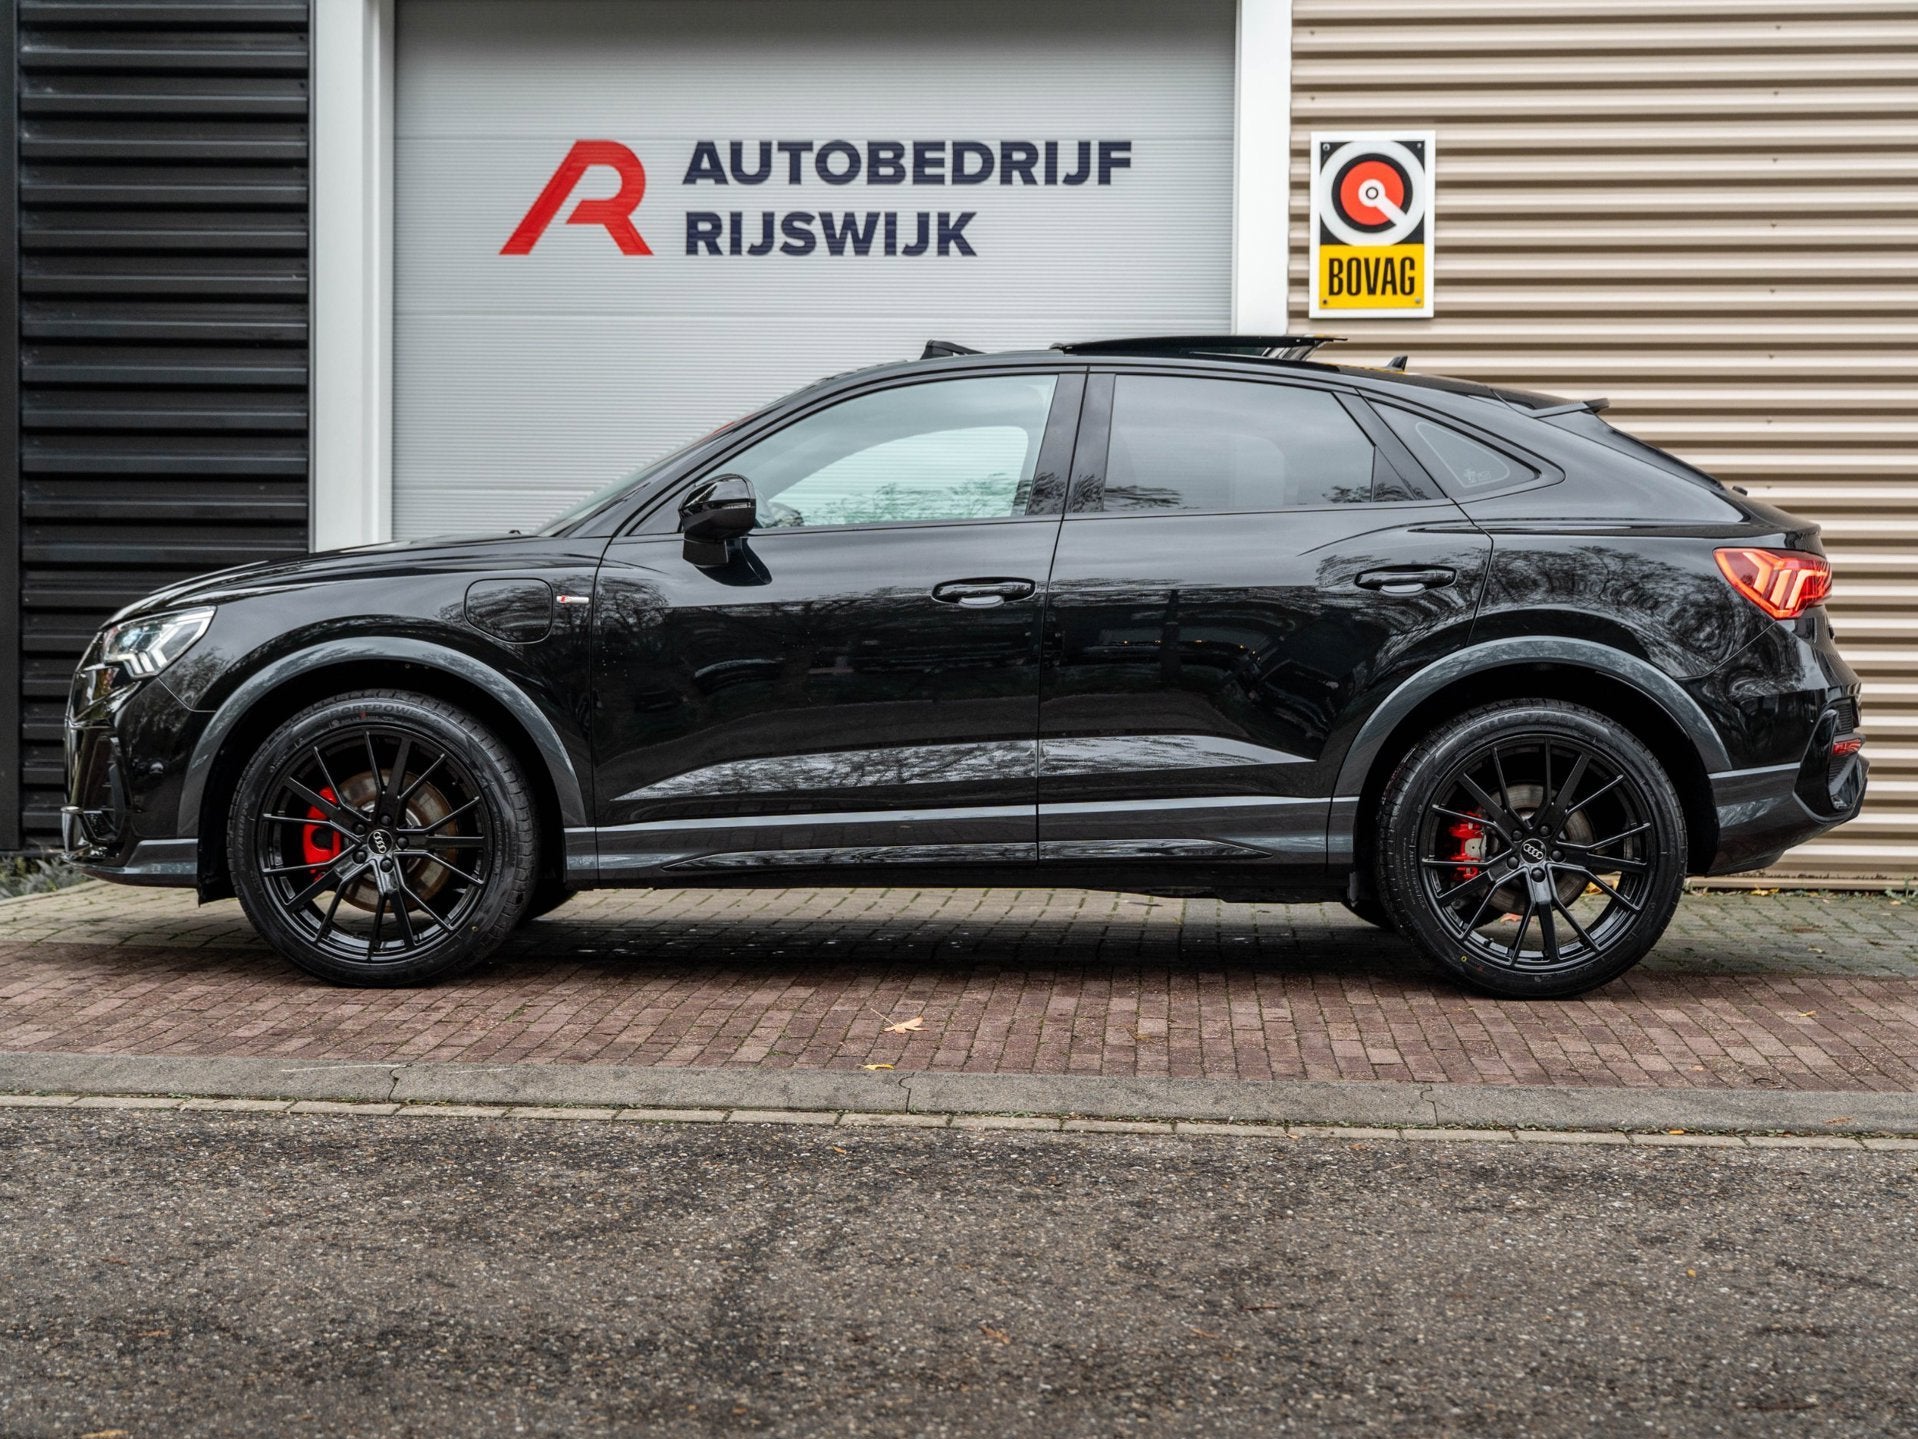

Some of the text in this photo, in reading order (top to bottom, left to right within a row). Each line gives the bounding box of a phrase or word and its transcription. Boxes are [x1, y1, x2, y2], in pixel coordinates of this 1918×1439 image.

[683, 140, 1131, 186] AUTOBEDRIJF
[685, 211, 977, 256] RIJSWIJK
[1329, 257, 1415, 296] BOVAG
